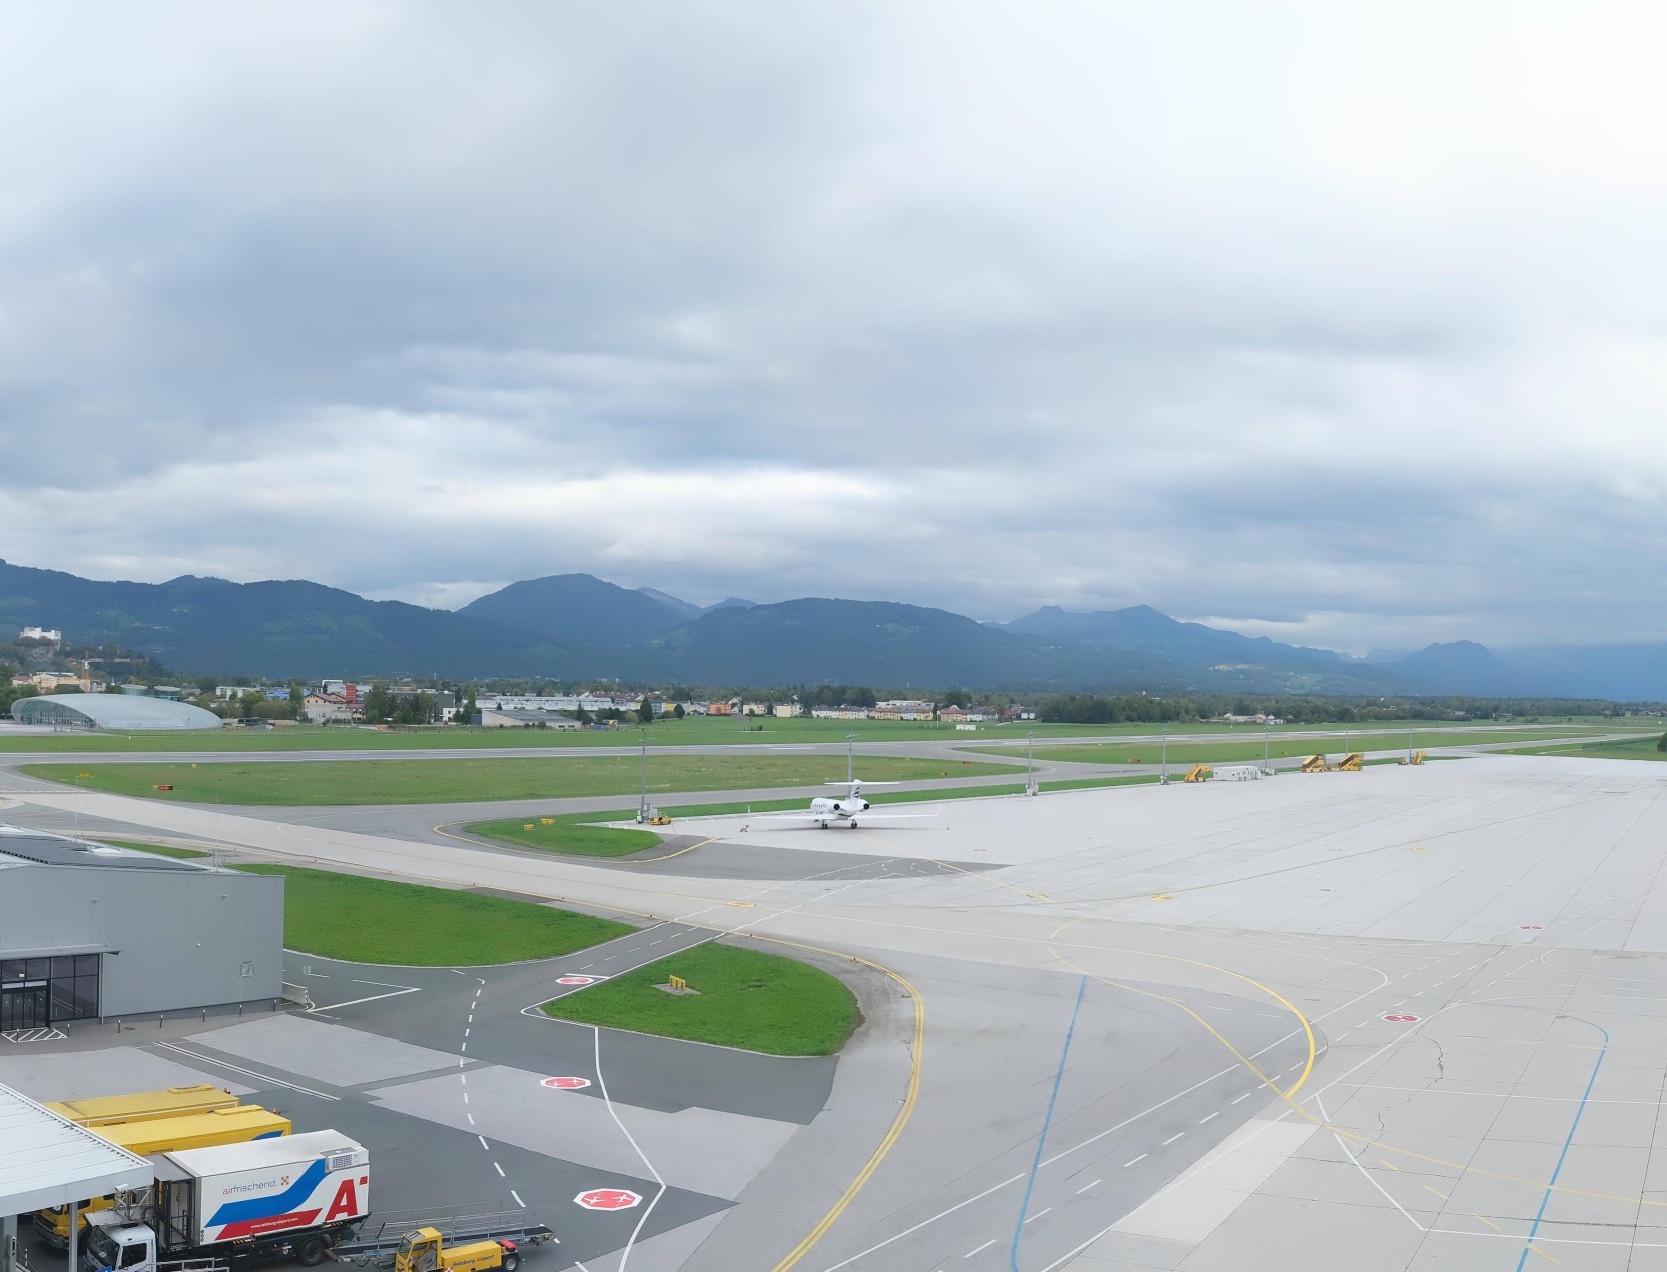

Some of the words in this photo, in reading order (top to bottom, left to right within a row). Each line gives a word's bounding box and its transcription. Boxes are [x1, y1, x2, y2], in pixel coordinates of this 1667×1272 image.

[222, 1180, 278, 1196] airfrischend.
[324, 1178, 359, 1222] A
[251, 1217, 299, 1230] www.salzburg-airport.com
[452, 1258, 476, 1268] Salzburg
[476, 1254, 495, 1264] Airport
